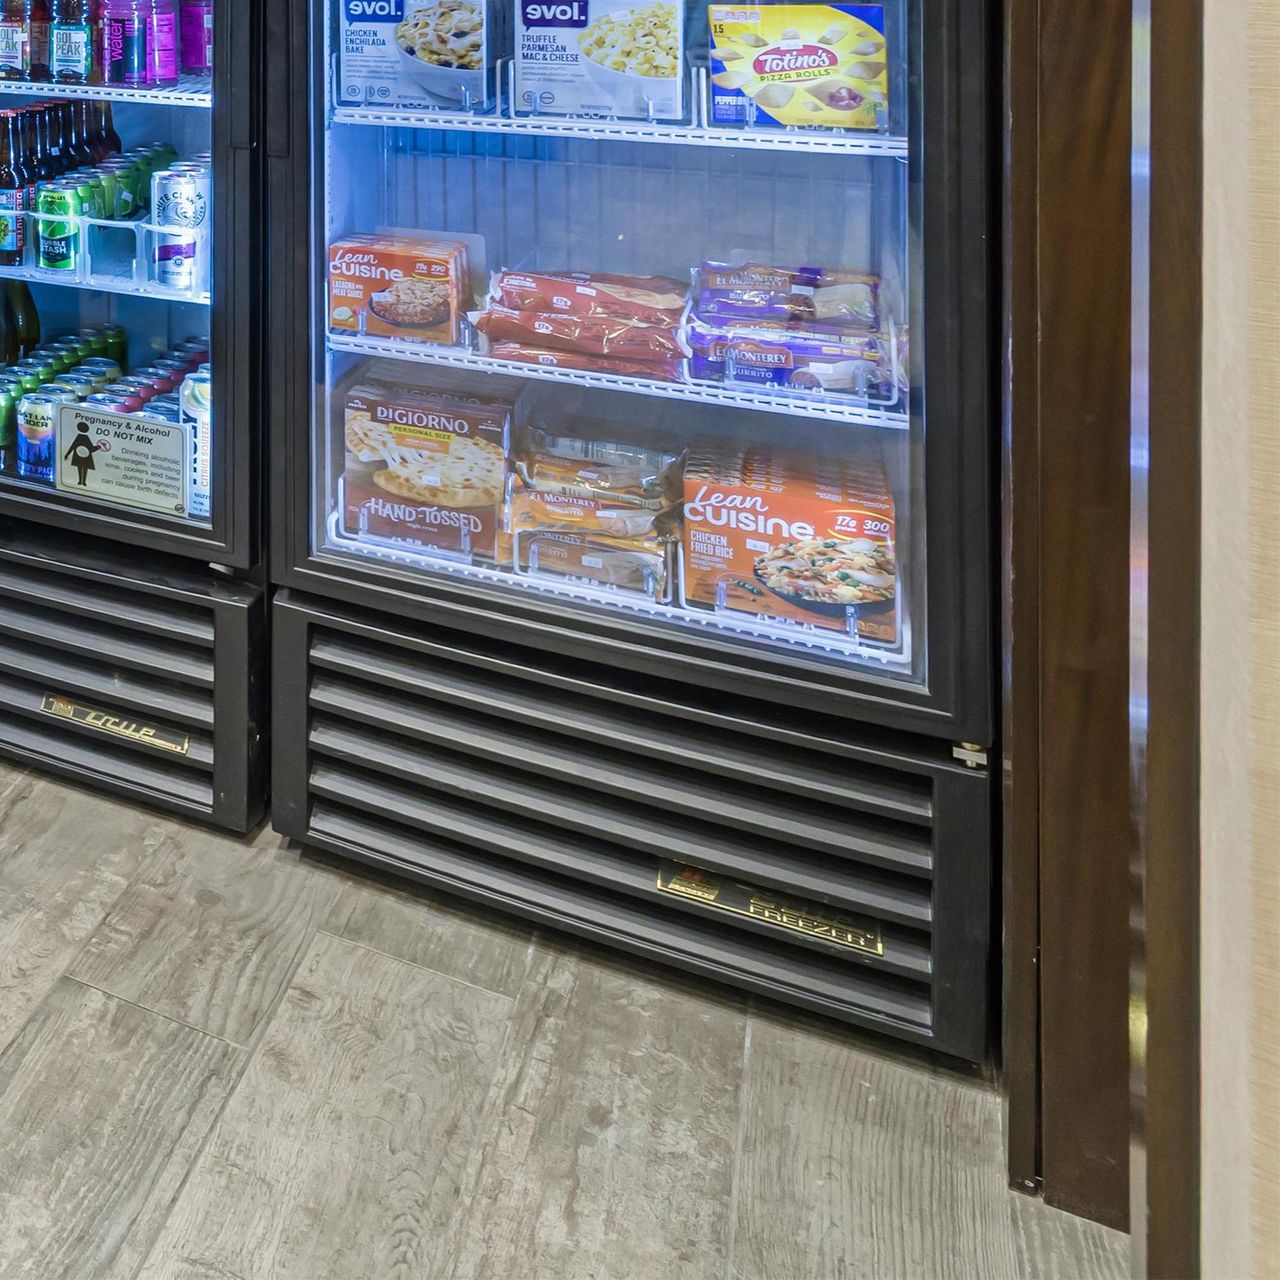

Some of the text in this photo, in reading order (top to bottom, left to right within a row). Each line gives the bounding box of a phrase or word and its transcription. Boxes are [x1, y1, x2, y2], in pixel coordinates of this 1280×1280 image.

[526, 3, 586, 21] evol.
[345, 28, 378, 38] CHICKEN
[521, 34, 557, 44] TRUFFLE
[345, 37, 387, 47] ENCHILADA
[345, 45, 365, 54] BAKE
[521, 43, 567, 53] PARMESAN
[757, 48, 831, 73] Totino's
[760, 68, 831, 82] PIZZA ROLLS
[333, 249, 379, 265] Lean
[736, 348, 786, 364] MONTEREY
[74, 412, 171, 438] Pregnancy & Alcohol
[96, 427, 154, 445] DO NOT MIX
[121, 447, 181, 466] Drinking alcoholic
[124, 465, 149, 476] coolers
[150, 469, 164, 479] and
[165, 472, 181, 482] beer
[150, 462, 181, 476] including
[101, 477, 114, 485] can
[115, 479, 137, 490] cause
[136, 482, 153, 494] birth
[122, 473, 181, 493] during pregnancy
[693, 486, 769, 512] Lean
[364, 497, 483, 534] HAND-TOSSED
[690, 531, 728, 545] CHICKEN
[749, 898, 870, 946] FREEZER
